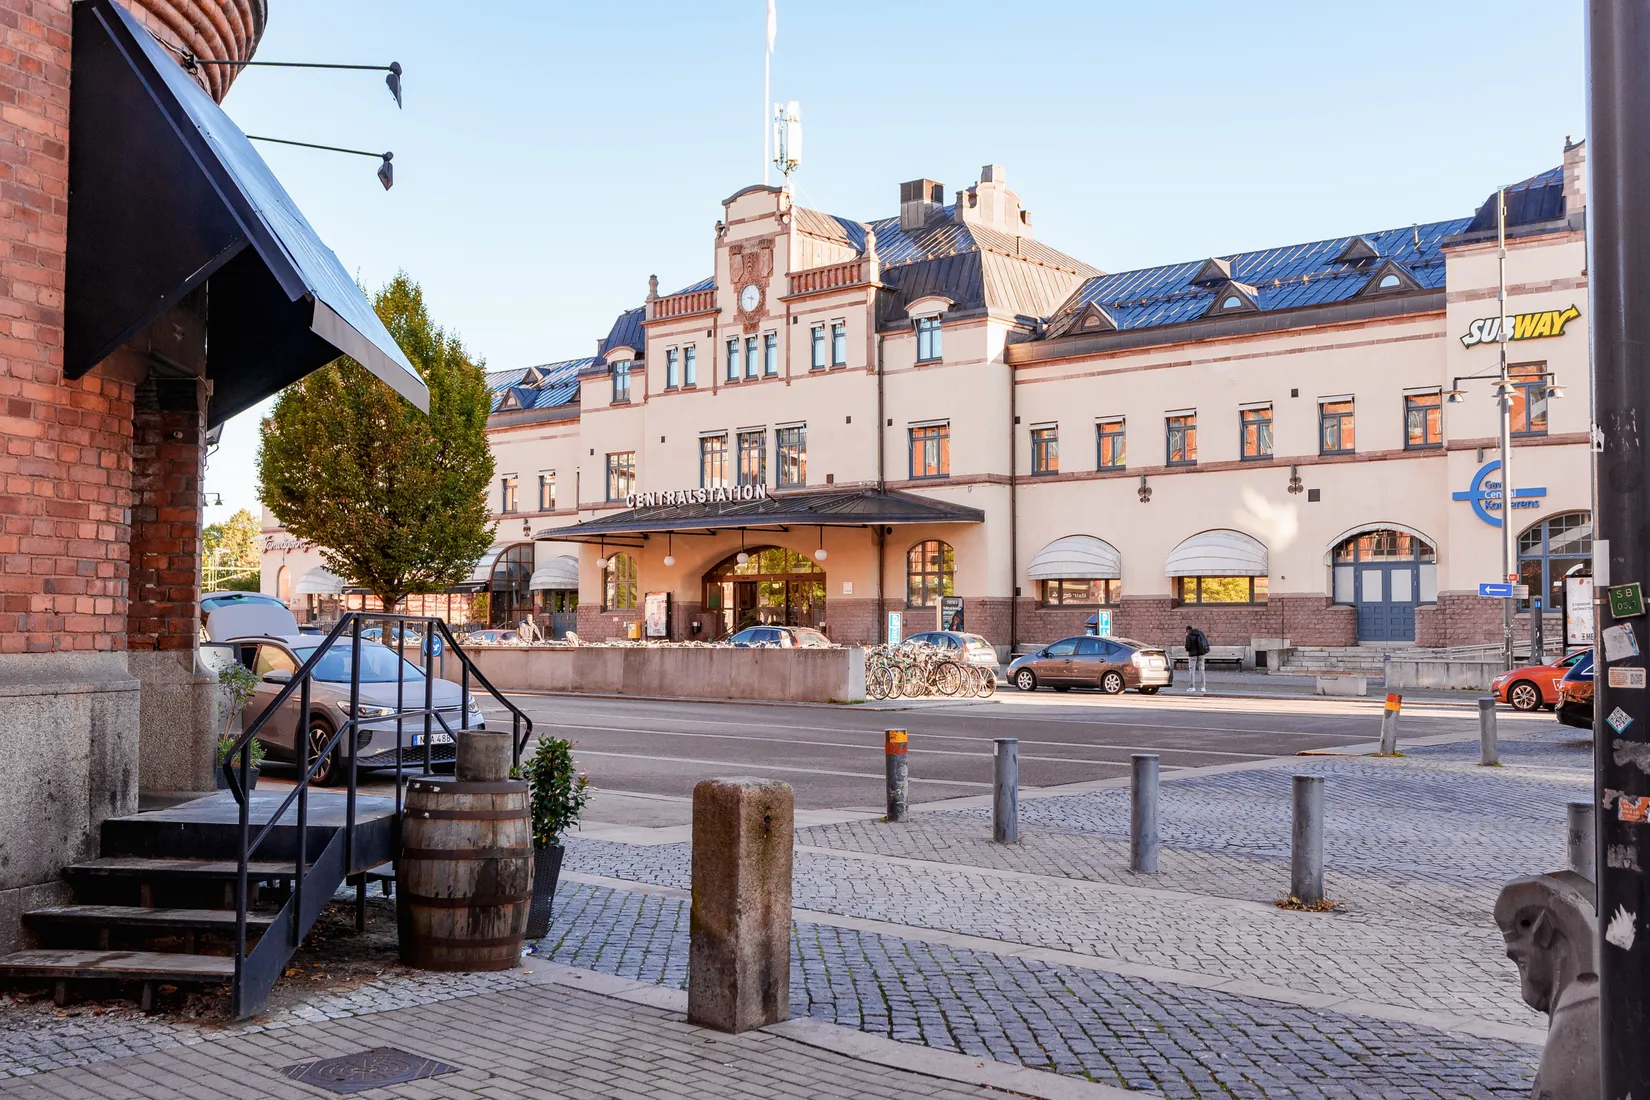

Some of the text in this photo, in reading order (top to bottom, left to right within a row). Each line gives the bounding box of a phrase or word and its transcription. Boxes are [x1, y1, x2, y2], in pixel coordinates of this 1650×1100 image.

[1461, 304, 1581, 349] SUBWAY
[626, 483, 767, 508] CENTRALSTATION
[1484, 489, 1517, 499] Cenal
